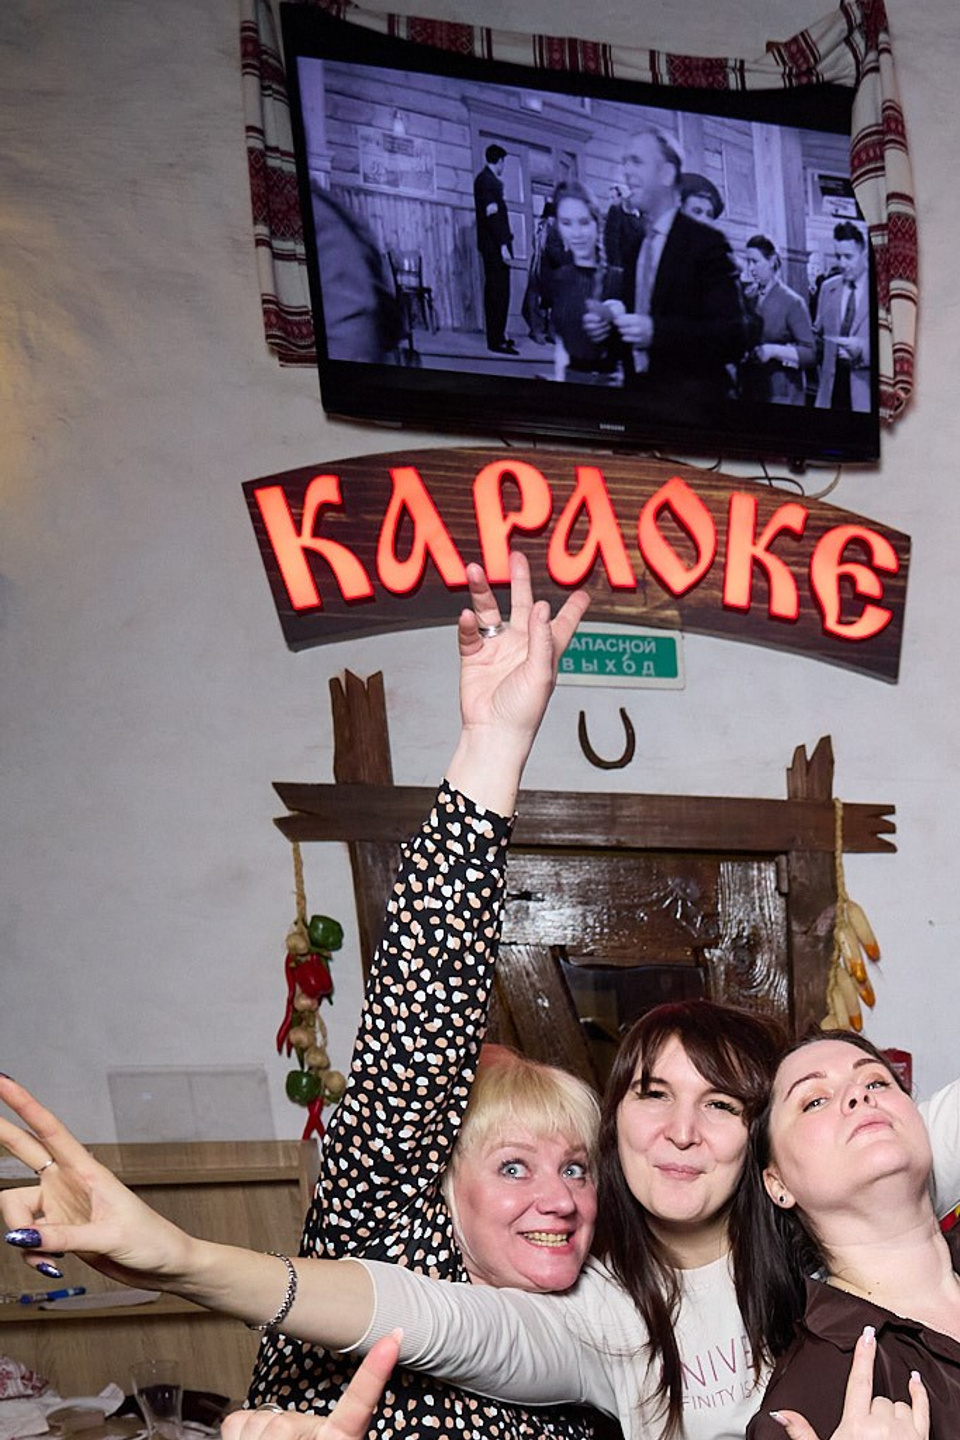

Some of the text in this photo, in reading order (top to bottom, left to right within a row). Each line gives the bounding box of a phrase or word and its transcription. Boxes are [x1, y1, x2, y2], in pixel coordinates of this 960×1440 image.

[568, 637, 656, 653] АПАСНОЙ
[562, 656, 655, 676] ВЫХОД
[662, 1334, 756, 1391] NIVE
[681, 1384, 736, 1411] FINITY
